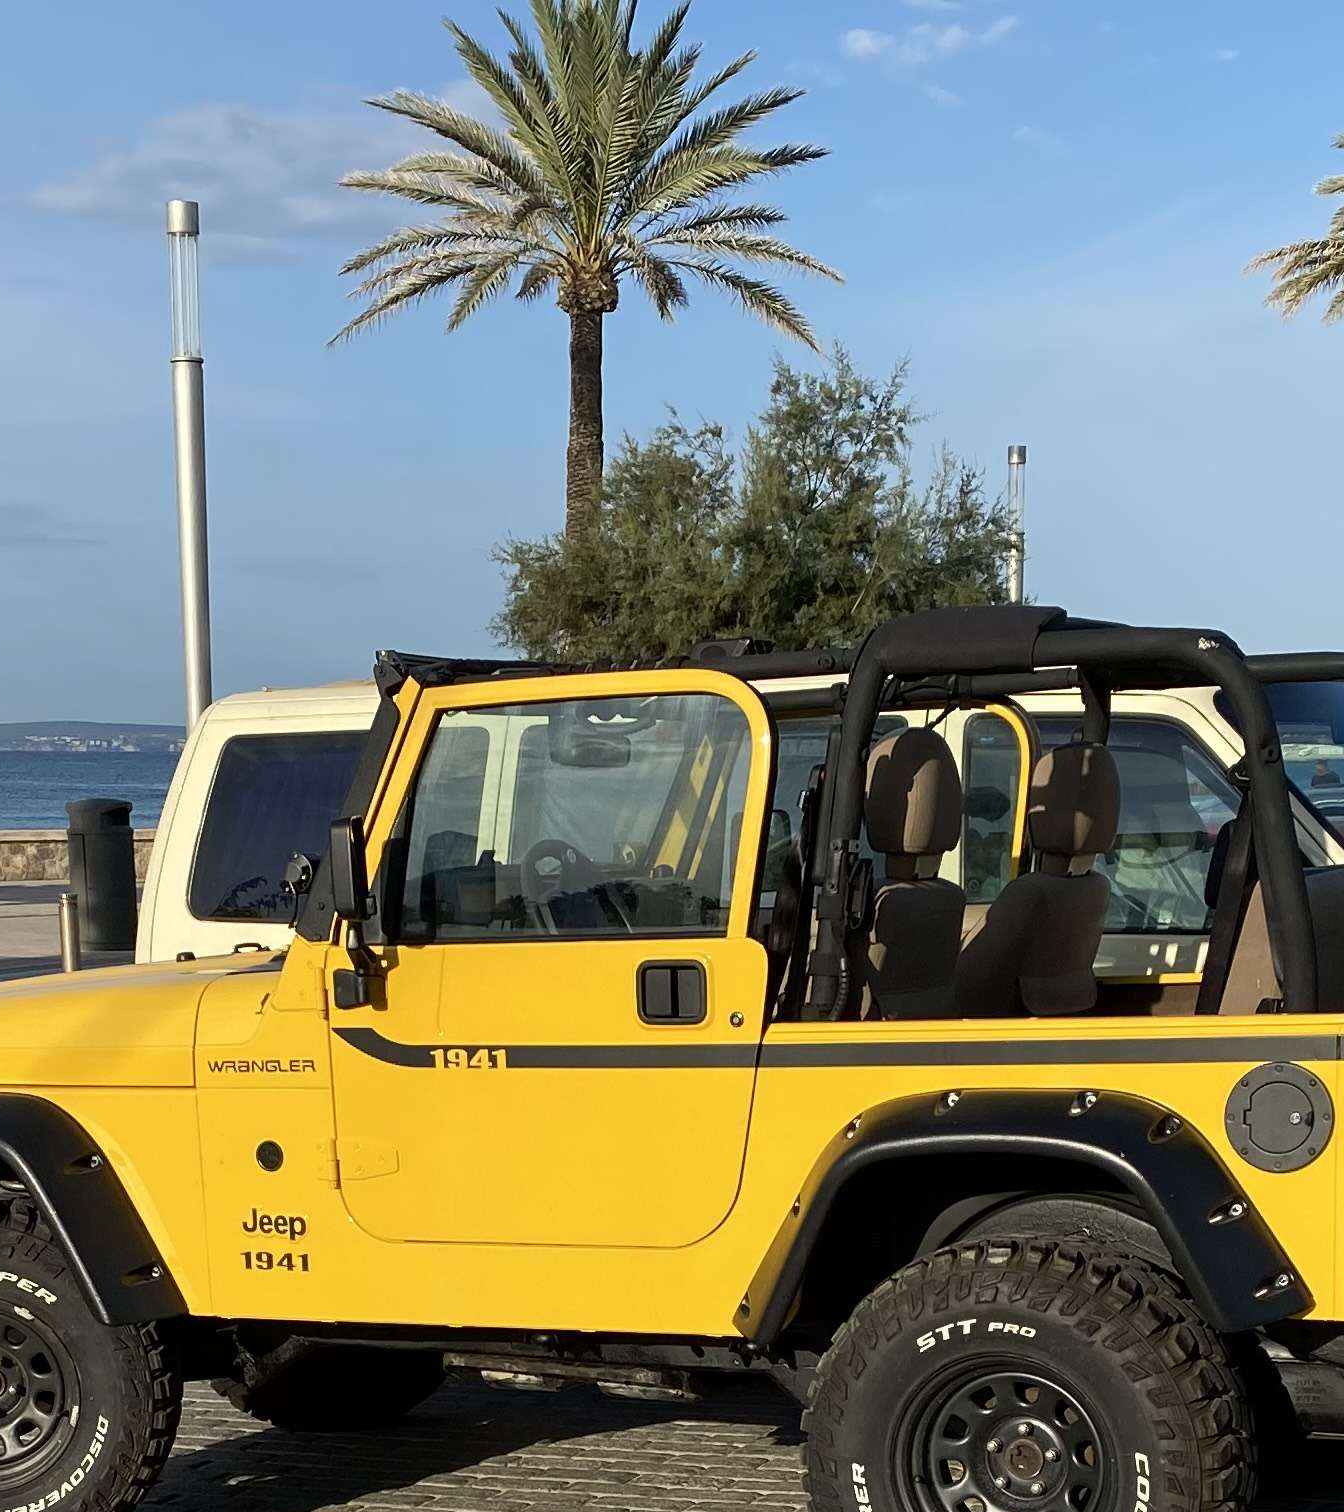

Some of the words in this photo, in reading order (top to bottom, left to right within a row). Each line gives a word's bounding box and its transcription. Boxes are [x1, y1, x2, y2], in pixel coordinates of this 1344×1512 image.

[430, 1048, 507, 1069] 1941
[241, 1207, 307, 1241] Jeep
[240, 1251, 312, 1273] 1941
[915, 1318, 978, 1354] STT
[987, 1321, 1037, 1339] PRO
